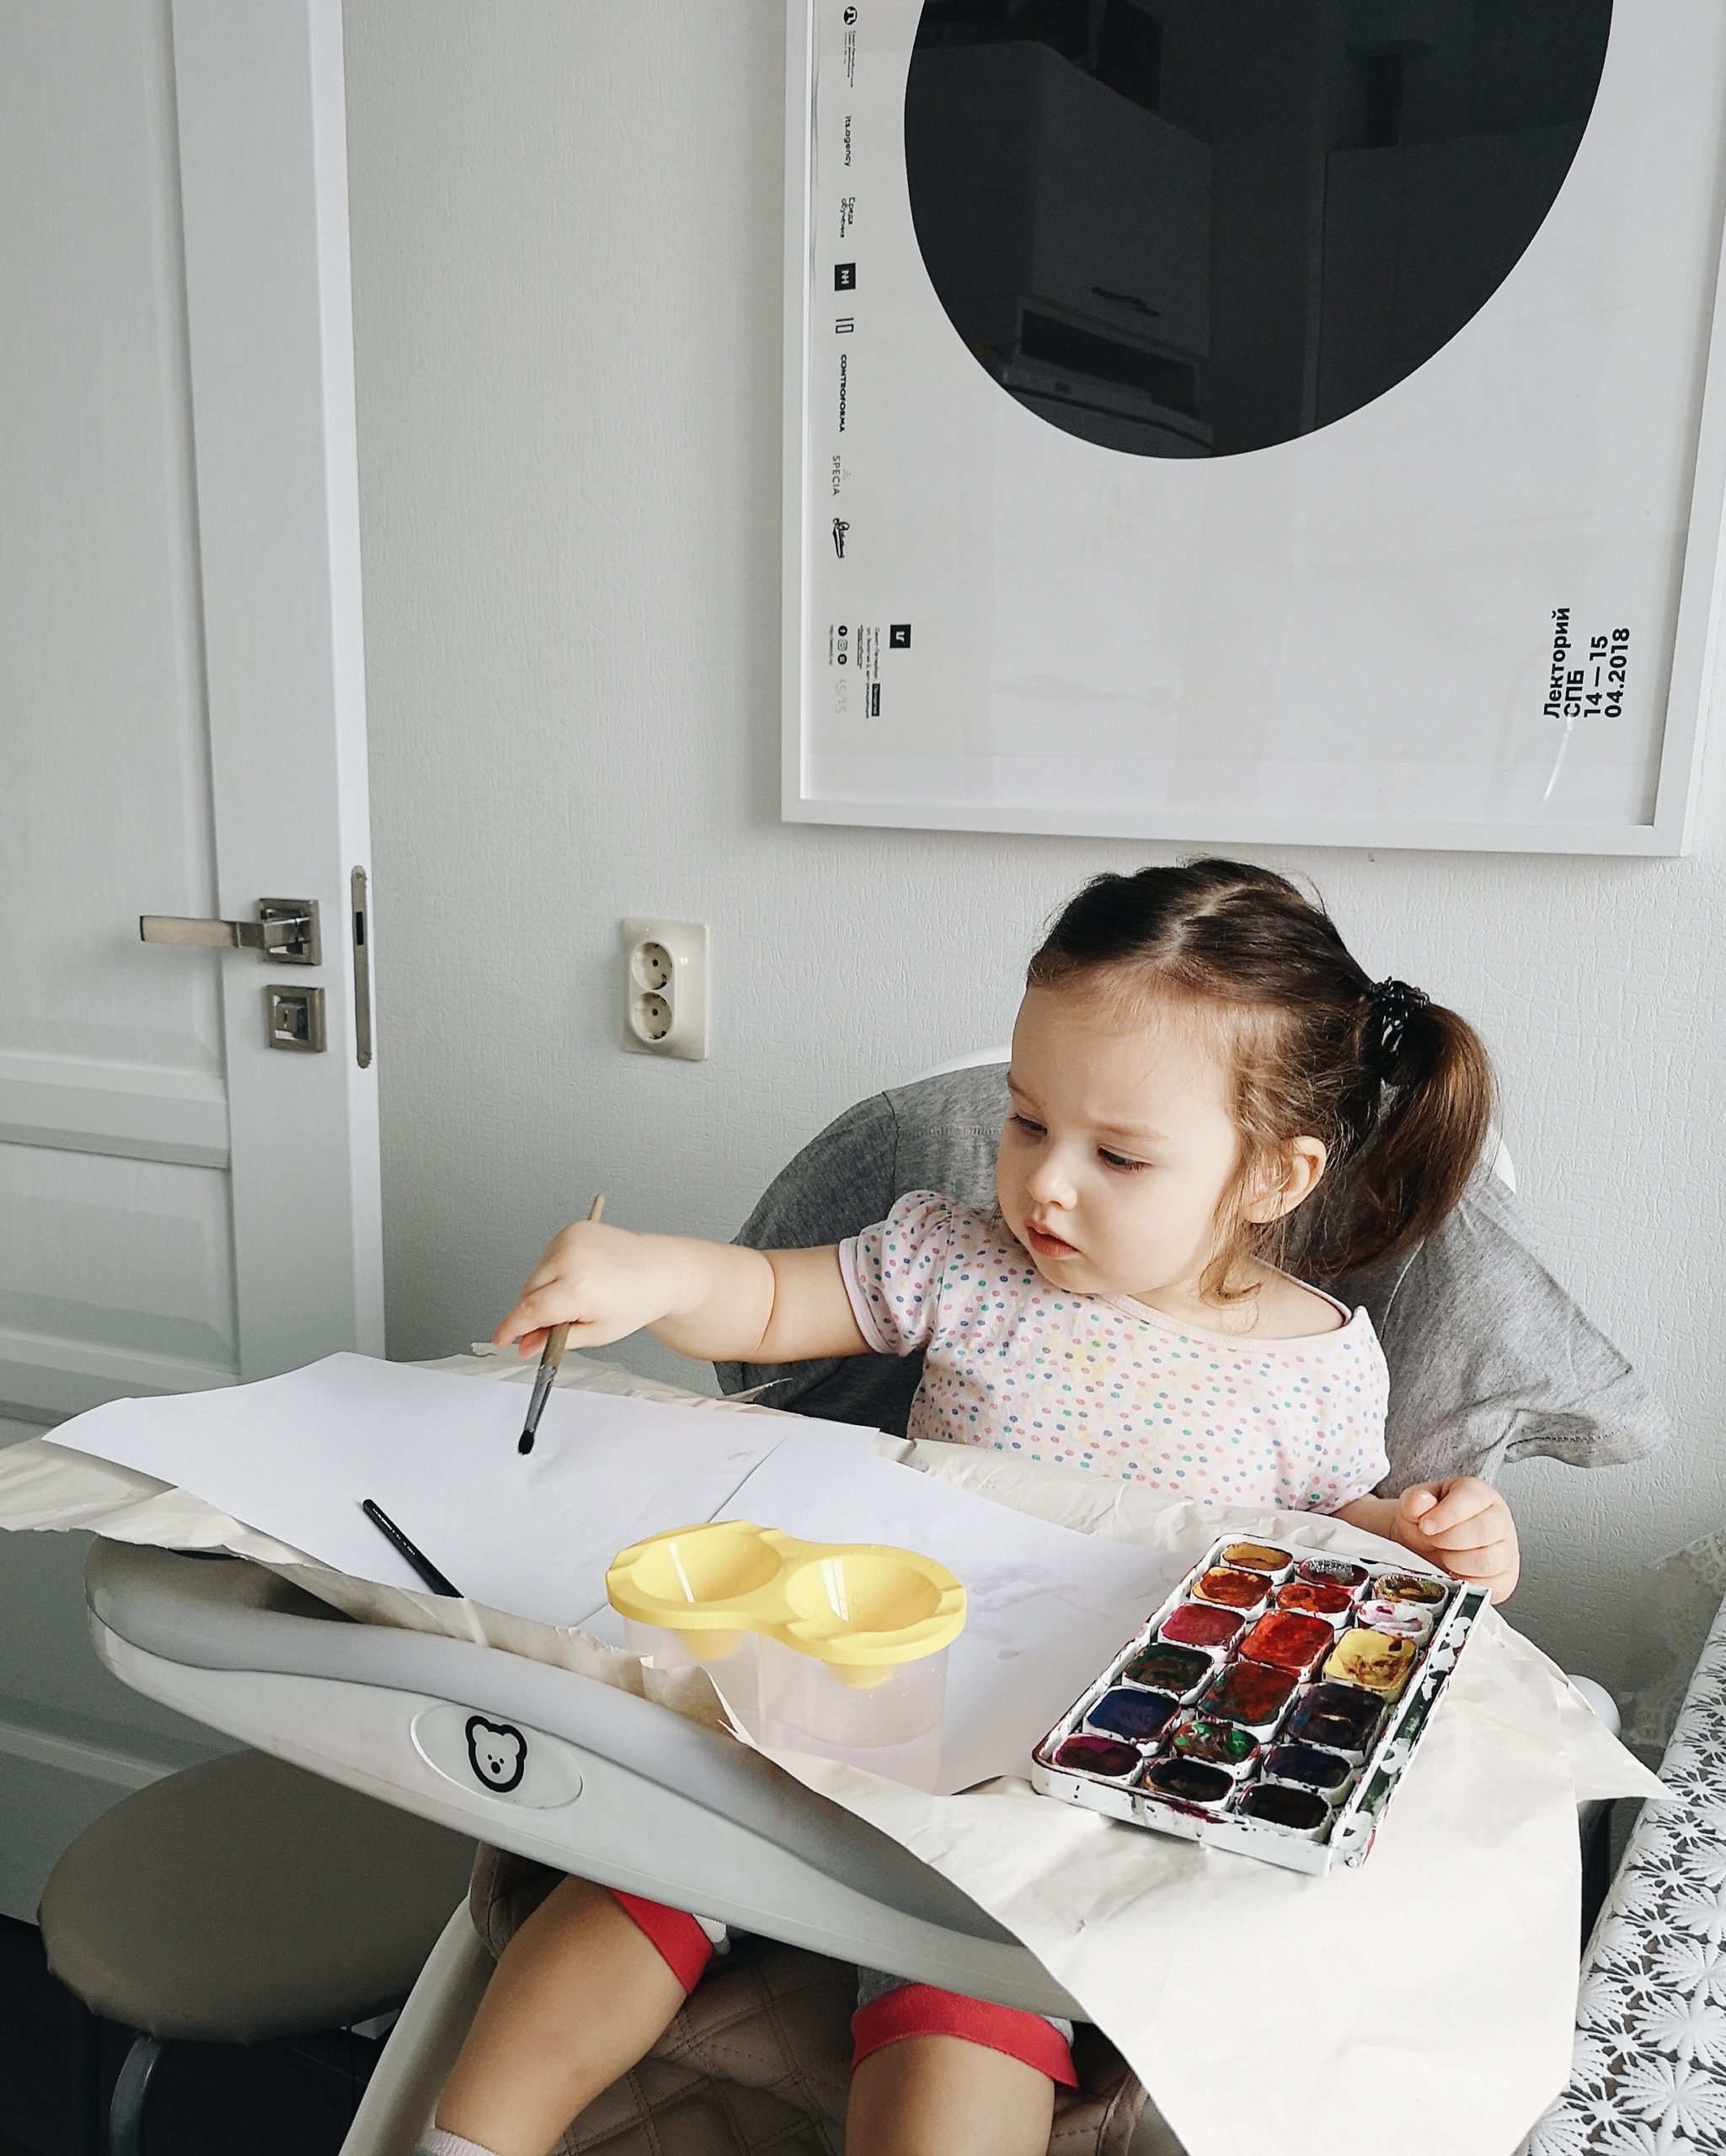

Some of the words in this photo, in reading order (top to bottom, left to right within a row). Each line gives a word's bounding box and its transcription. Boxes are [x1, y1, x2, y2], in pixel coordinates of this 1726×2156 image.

[839, 354, 847, 433] CONTROFORMA
[832, 456, 841, 496] SPECIA
[1543, 607, 1572, 718] Лекторий
[1590, 636, 1608, 661] 15
[1604, 628, 1630, 718] 04.2018
[1563, 670, 1584, 718] СПБ
